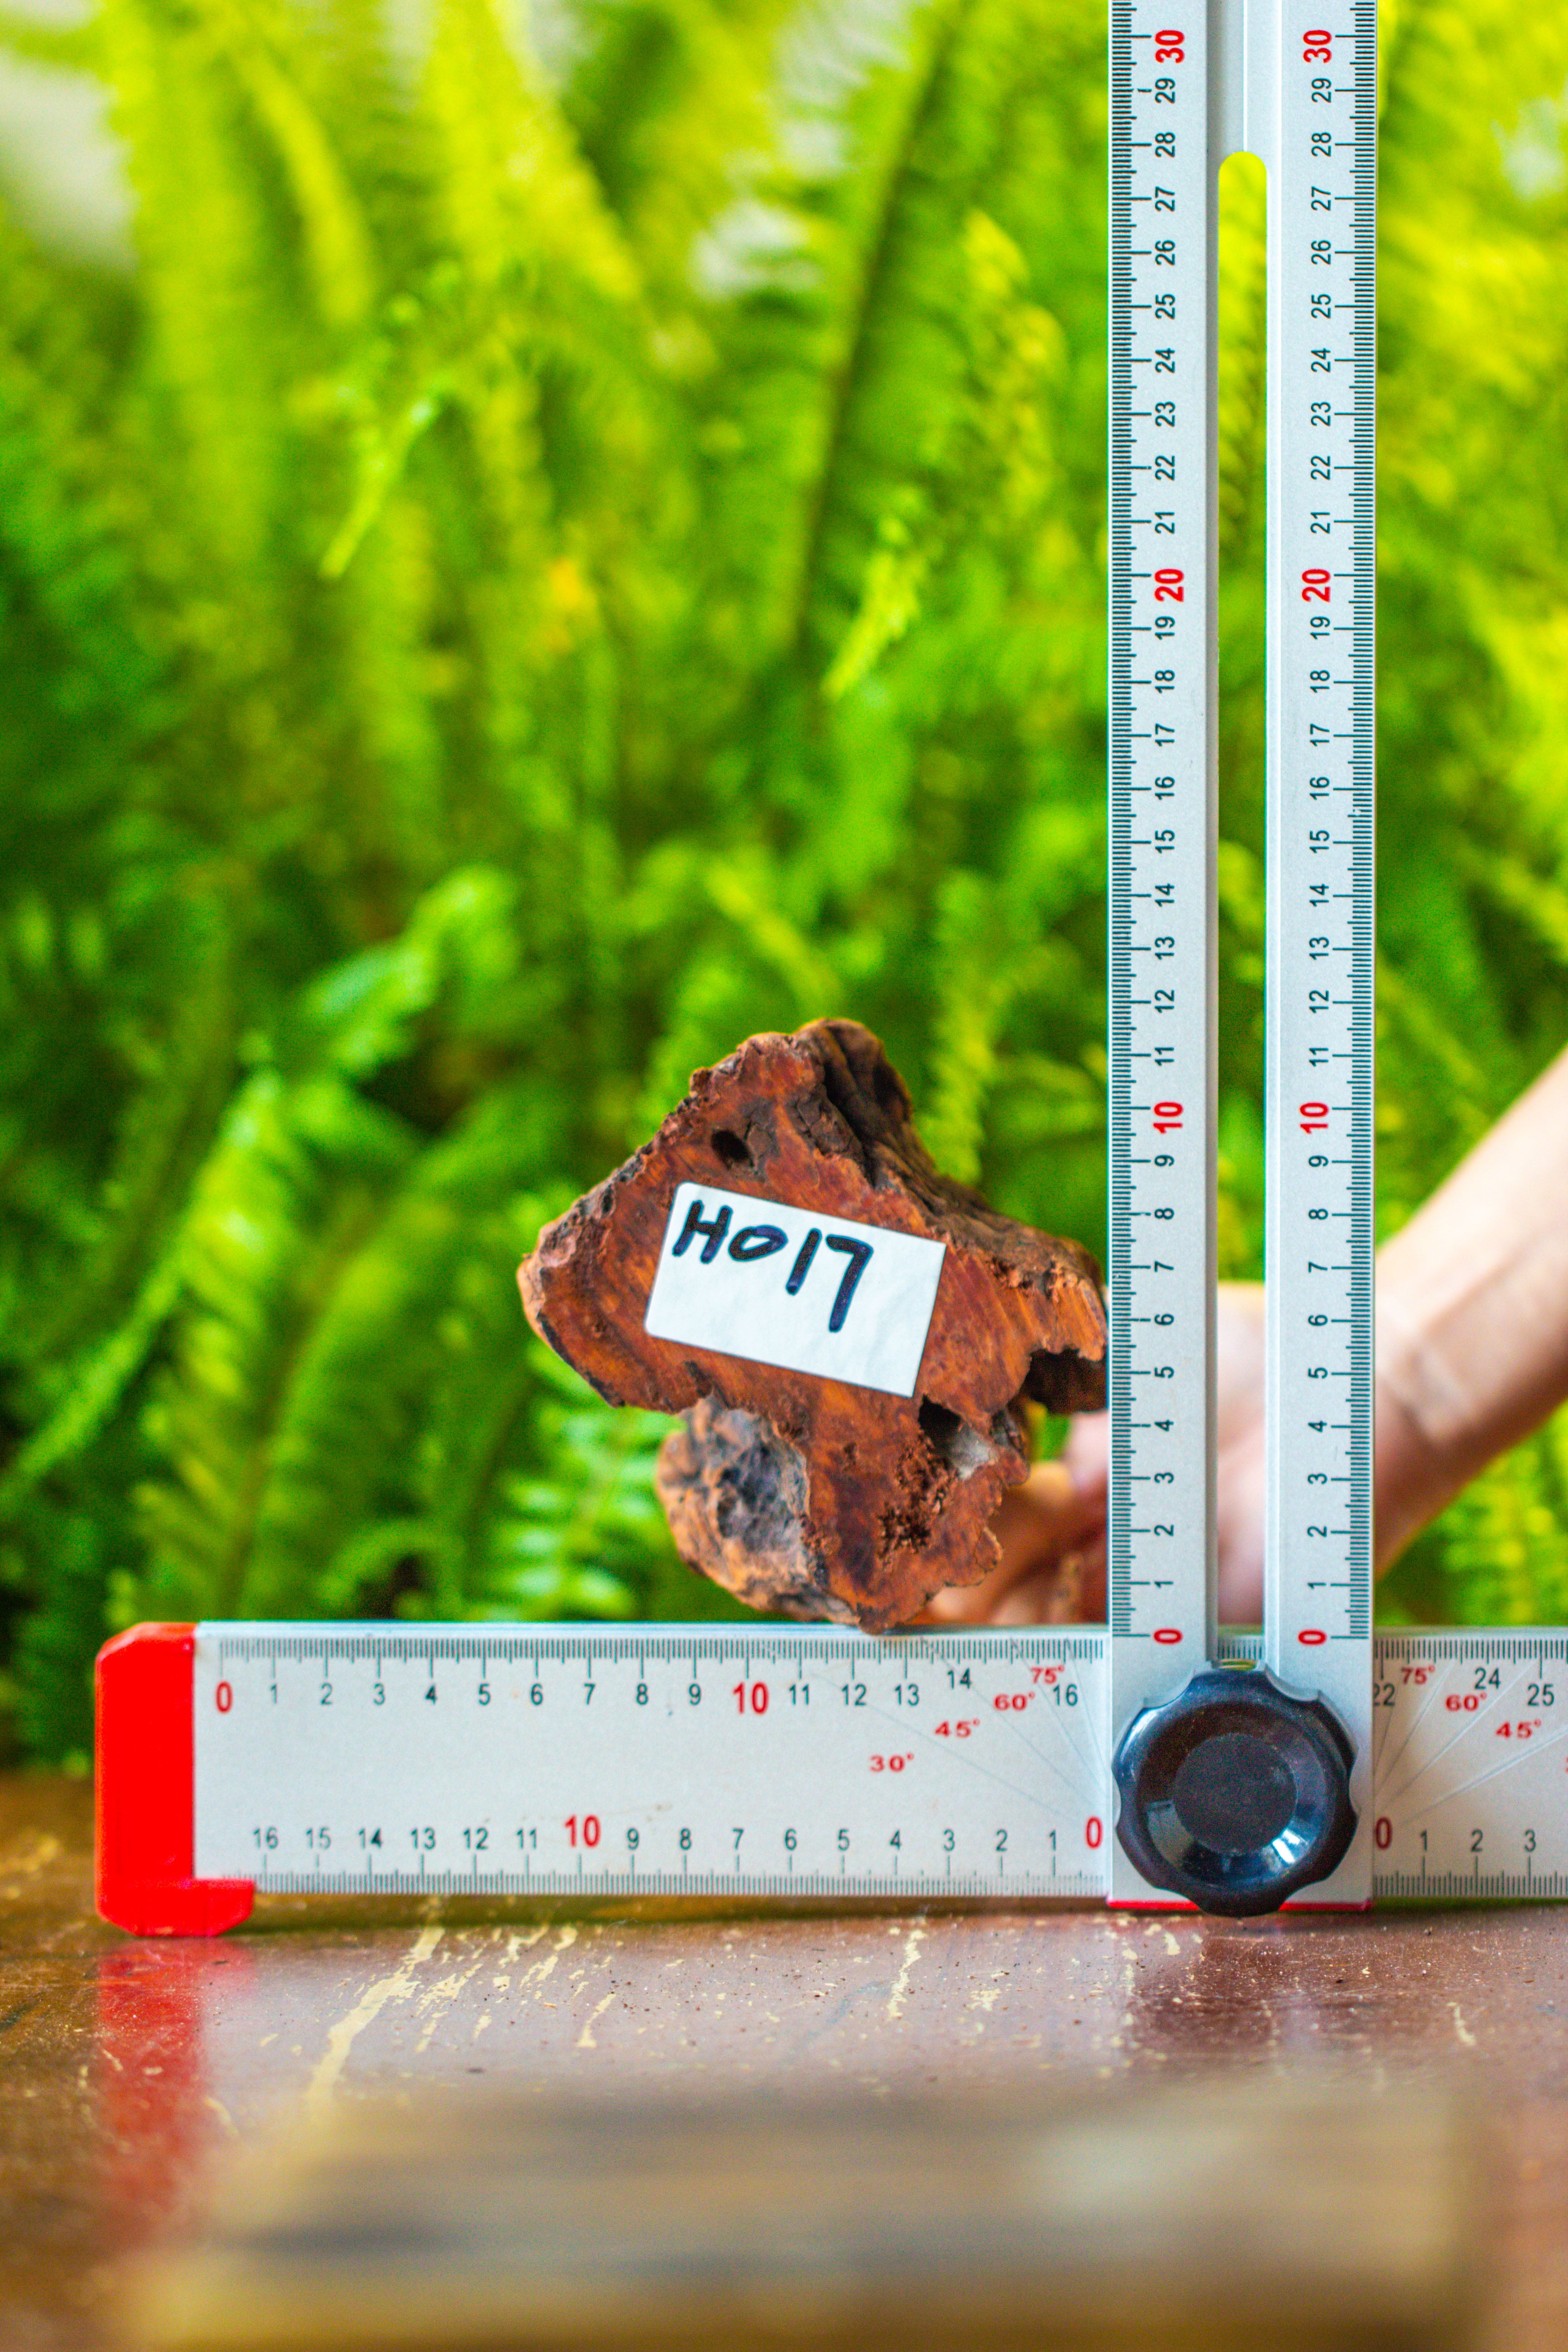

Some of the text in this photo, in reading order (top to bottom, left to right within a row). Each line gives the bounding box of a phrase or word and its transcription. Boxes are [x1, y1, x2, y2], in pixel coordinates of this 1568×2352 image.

[1152, 29, 1185, 1644] 0 1 2 3 4 5 6 7 8 9 10 11 12 13 14 15 16 17 18 19 20 21 22 23 24 25 26 27 28 29 30
[1298, 29, 1330, 1645] 0 1 2 3 4 5 6 7 8 9 10 11 12 13 14 15 16 17 18 19 20 21 22 23 24 25 26 27 28 29 30
[215, 1666, 1079, 1715] 0 1 2 3 4 5 6 7 8 9 10 11 12 13 14 16
[1473, 1667, 1501, 1690] 24
[1526, 1683, 1555, 1707] 25
[252, 1814, 1103, 1852] 16 15 14 13 12 11 10 9 8 7 6 5 4 3 2 1 0
[1375, 1817, 1537, 1853] 0 1 2 3
